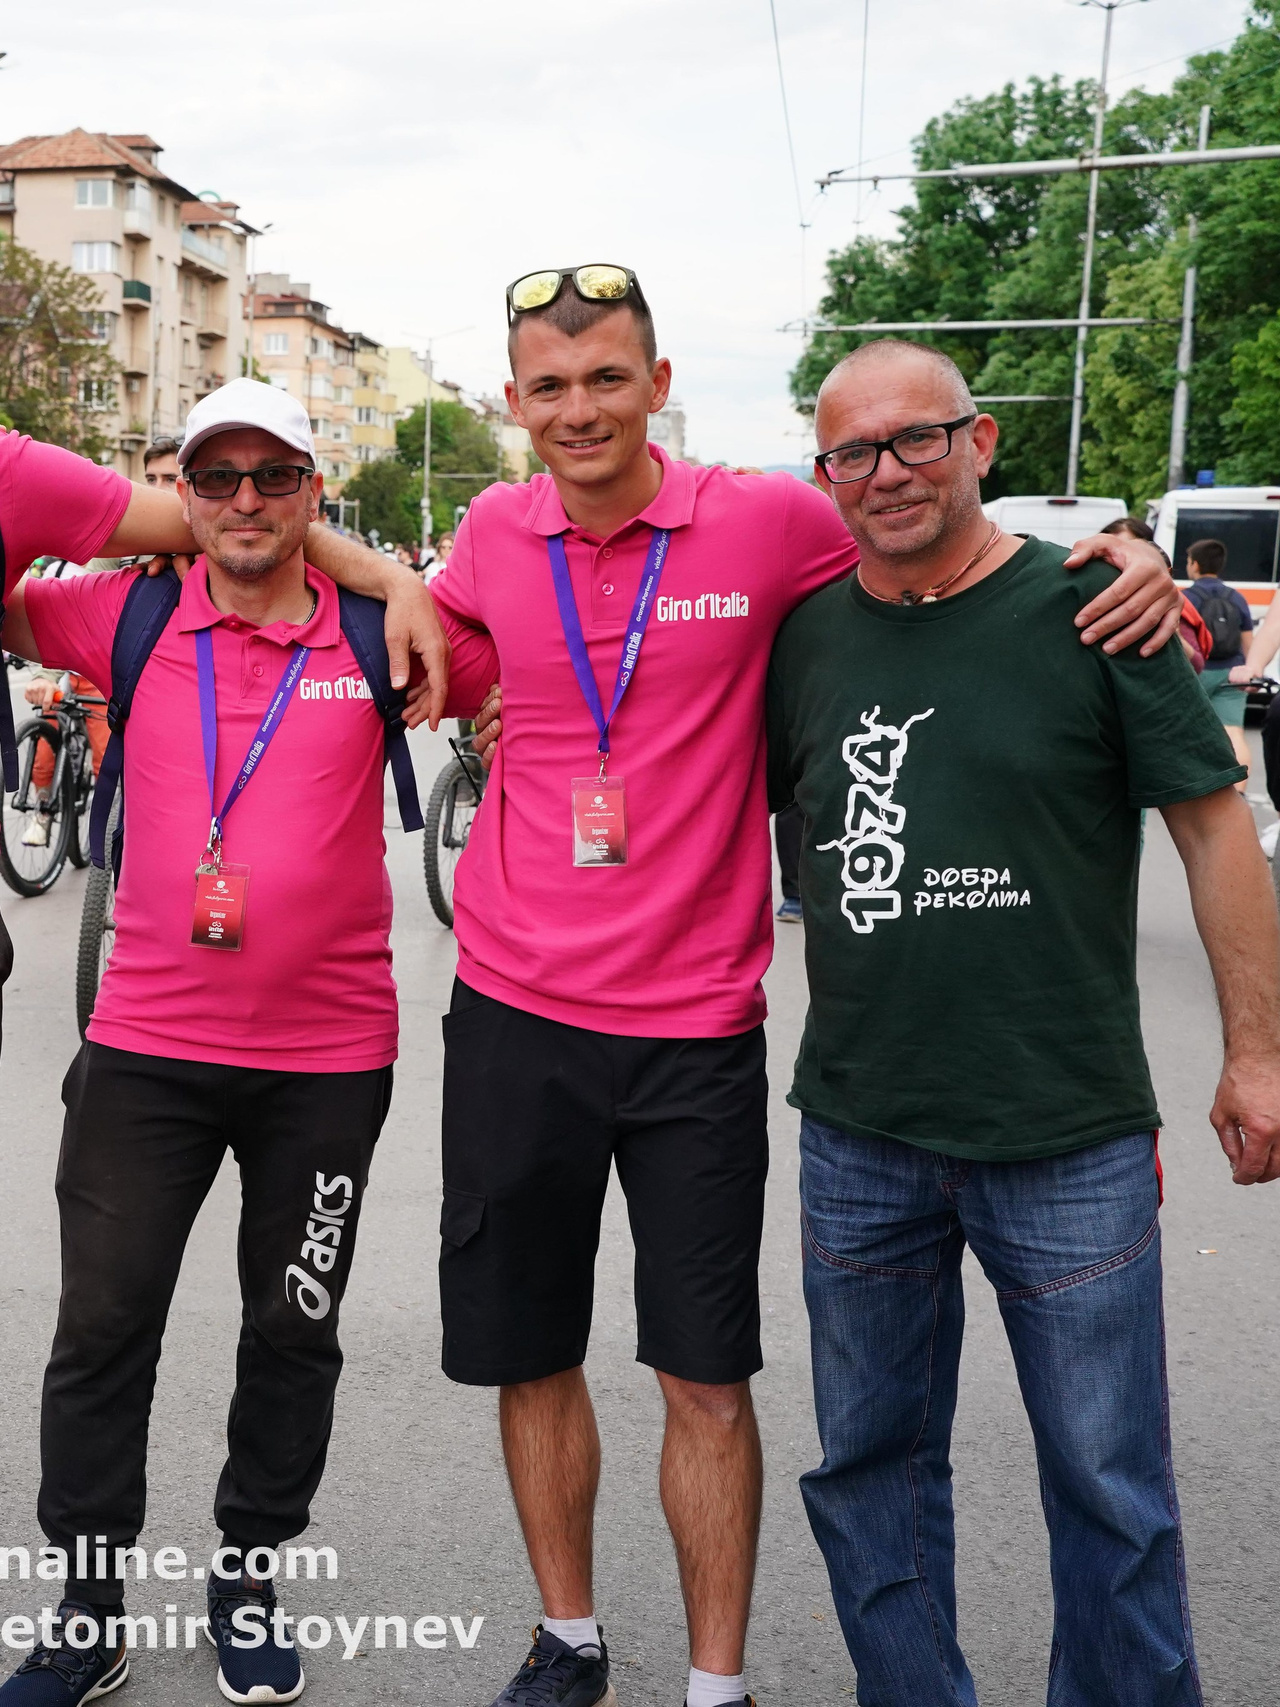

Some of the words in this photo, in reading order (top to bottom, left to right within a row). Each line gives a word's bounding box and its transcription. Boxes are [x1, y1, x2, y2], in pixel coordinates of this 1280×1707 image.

[642, 576, 654, 600] Partenza
[636, 600, 646, 622] Grande
[656, 596, 692, 622] Giro
[695, 592, 749, 620] d'Italia
[626, 632, 642, 656] d'Italia
[622, 654, 636, 670] Giro
[300, 678, 332, 700] Giro
[242, 760, 254, 774] Giro
[248, 740, 264, 762] d'Italia
[262, 714, 274, 732] Grande
[270, 692, 284, 714] Partenza
[838, 716, 912, 934] 1974
[924, 868, 1011, 894] ДОБРА
